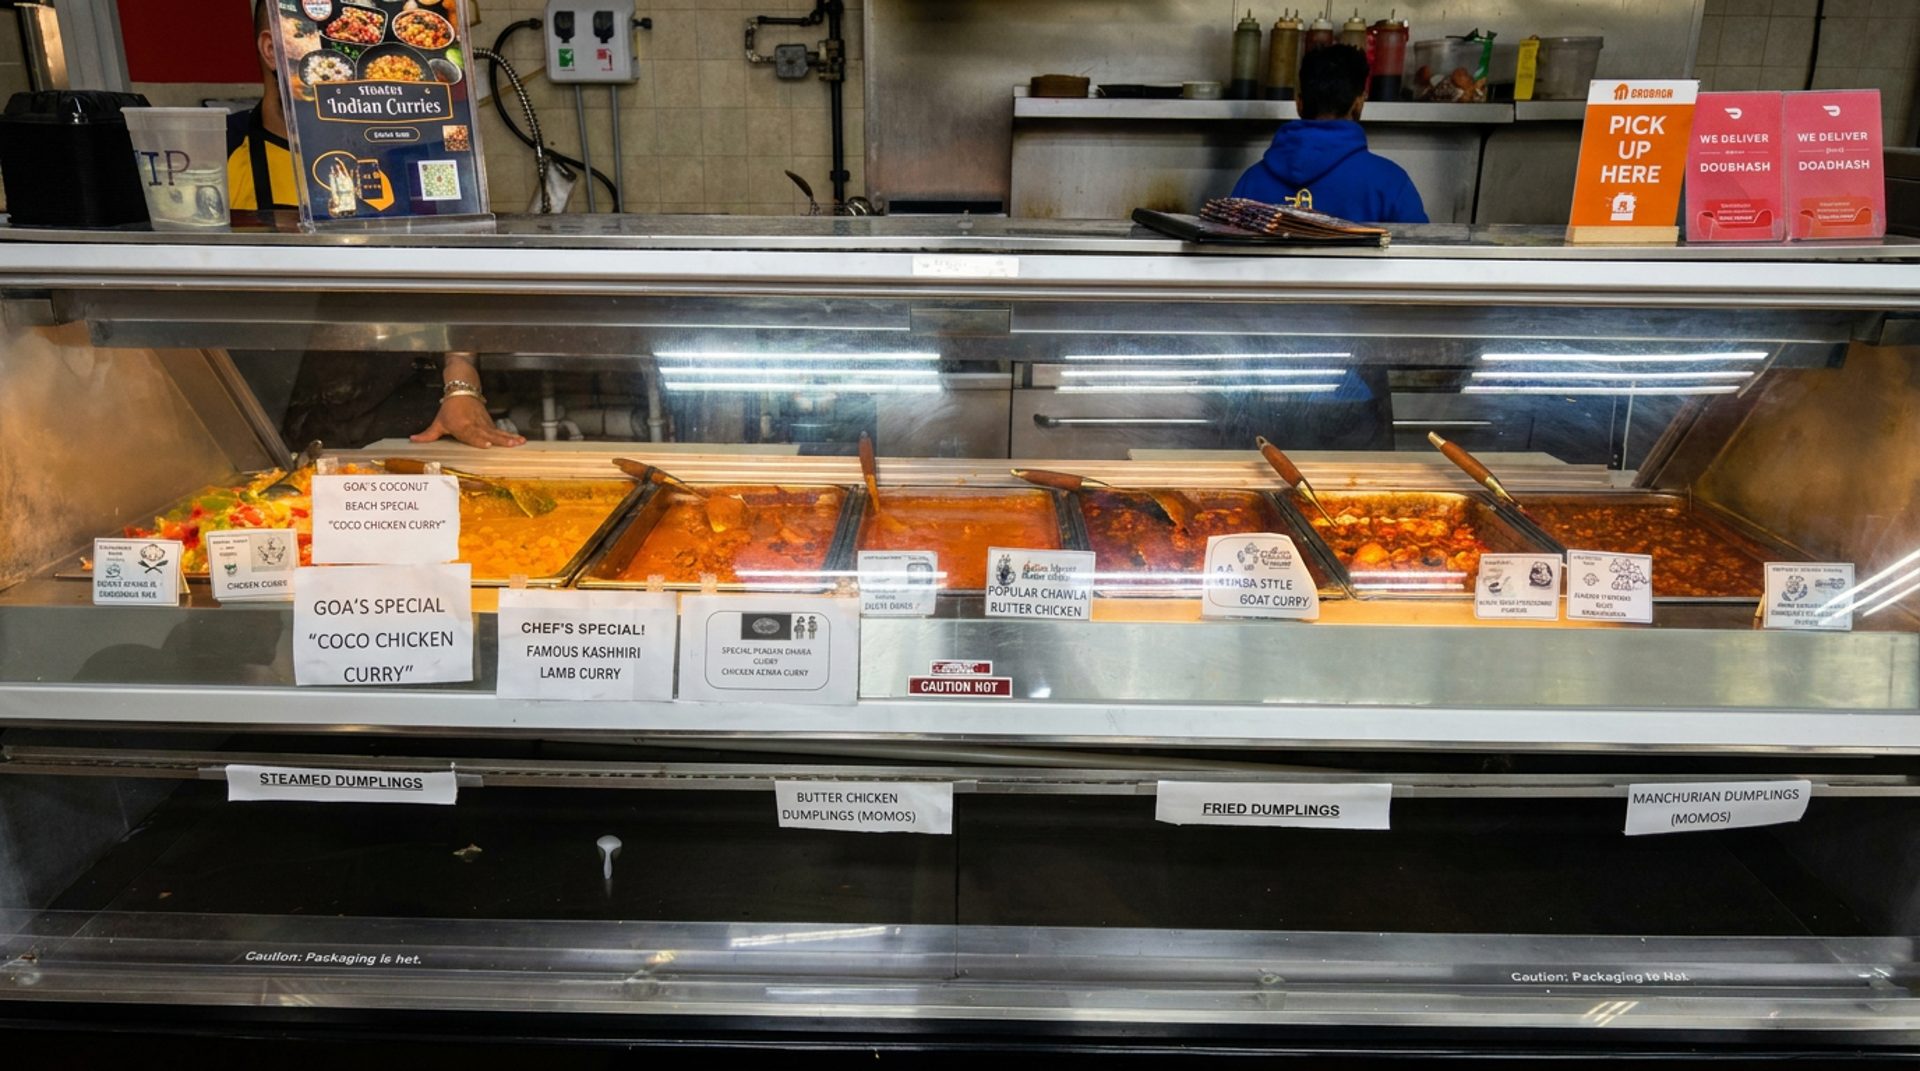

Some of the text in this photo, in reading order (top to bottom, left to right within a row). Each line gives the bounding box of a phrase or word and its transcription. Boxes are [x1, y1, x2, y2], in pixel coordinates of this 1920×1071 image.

[327, 97, 441, 116] Indian Curries
[1609, 115, 1667, 135] PICK
[1699, 133, 1769, 144] WE DELIVER
[1797, 132, 1868, 142] WE DELIVER
[1617, 140, 1652, 160] UP
[1600, 165, 1661, 184] HERE
[379, 481, 429, 492] COCONUT
[345, 501, 419, 511] BEACH SPECIAL
[364, 520, 406, 530] CHICKEN
[988, 586, 1087, 600] POPULAR CHAWLA
[313, 597, 445, 616] GOA'S SPECIAL
[1034, 604, 1082, 617] CHICKEN
[521, 622, 646, 636] CHEF'S SPECIAL!
[375, 630, 454, 649] CHICKEN
[526, 645, 580, 658] FAMOUS
[344, 664, 415, 684] CURRY"
[540, 667, 621, 680] LAMB CURRY
[260, 772, 424, 789] STEAMED DUMPLINGS
[797, 792, 898, 804] BUTTER CHICKEN
[1633, 788, 1800, 804] MANCHURIAN DUMPLINGS
[1203, 802, 1340, 816] FRIED DUMPLINGS
[782, 810, 917, 824] DUMPLINGS (MOMOS)
[1671, 811, 1732, 826] (MOMOS)
[305, 952, 377, 966] Packaging
[1572, 971, 1643, 983] Packaging
